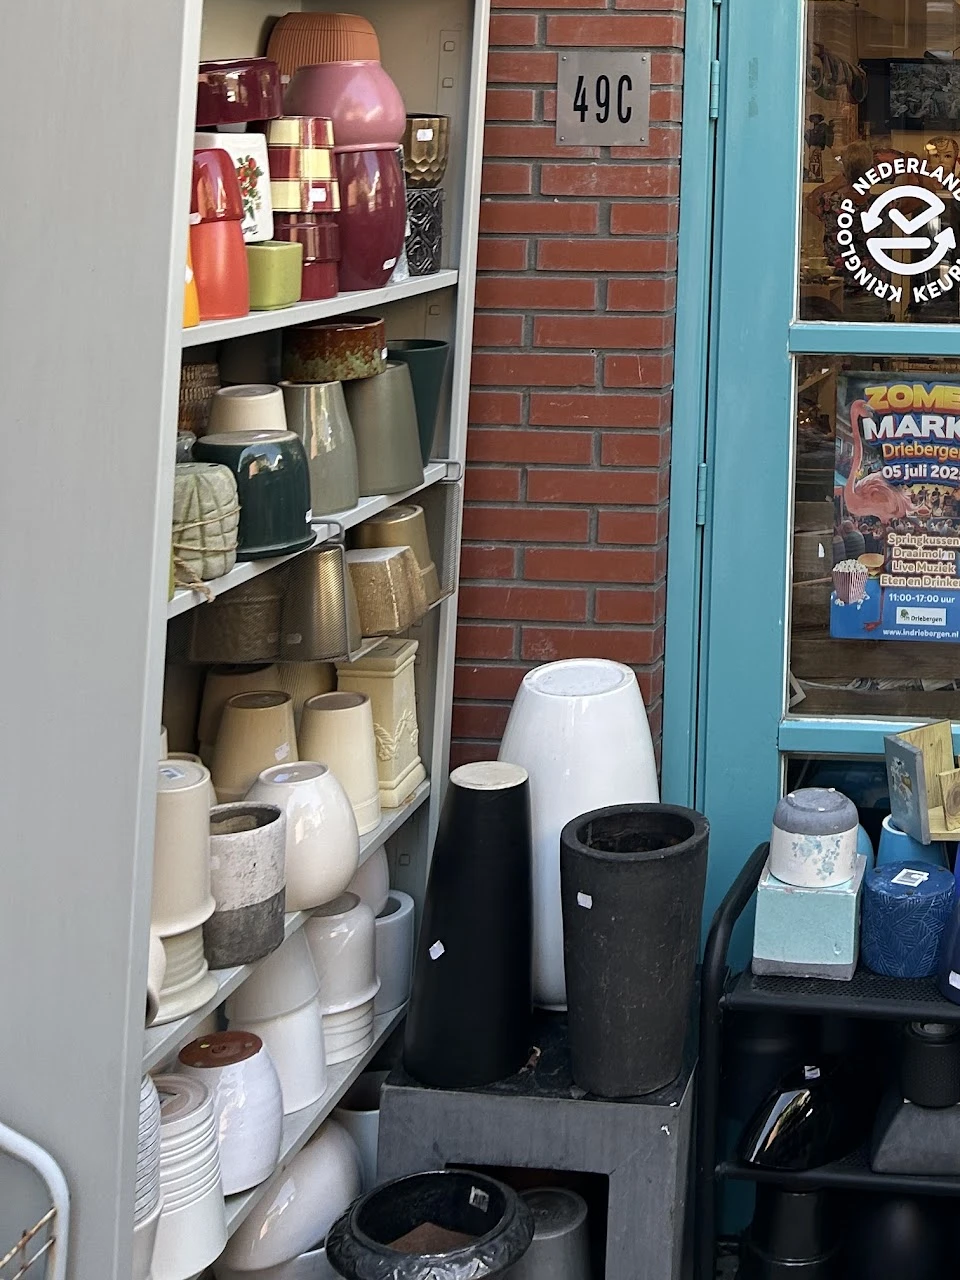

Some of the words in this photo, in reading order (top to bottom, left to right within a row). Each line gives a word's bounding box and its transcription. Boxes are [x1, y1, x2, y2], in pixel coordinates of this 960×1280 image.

[573, 74, 633, 124] 49C
[836, 198, 902, 303] KRINGLOOP
[881, 465, 902, 479] 05
[904, 463, 927, 479] juli
[887, 532, 960, 547] Springkussen
[891, 560, 916, 572] Live
[916, 561, 956, 574] Muziek
[880, 574, 906, 586] Eten
[906, 577, 921, 587] en
[888, 592, 939, 603] 11:00-17:00
[910, 615, 943, 624] Driebergen
[882, 628, 960, 639] www.indriebergen.nl
